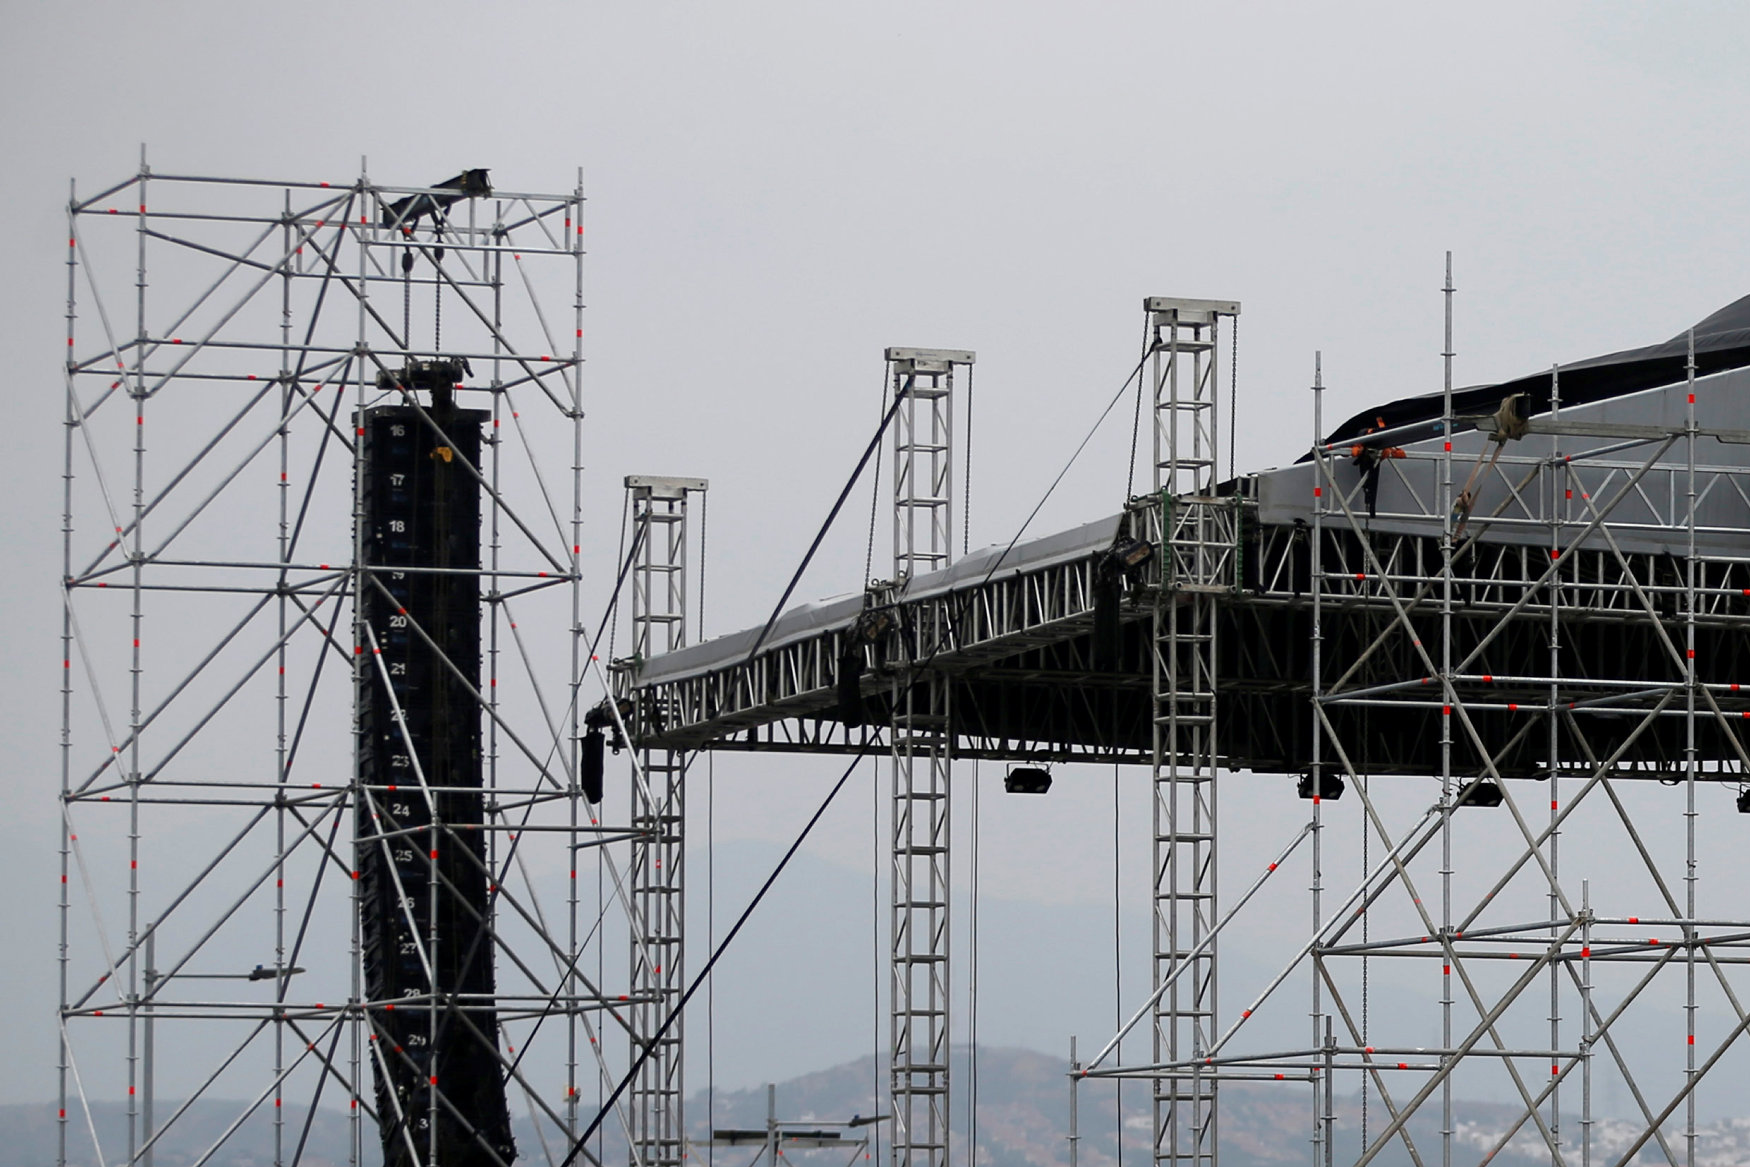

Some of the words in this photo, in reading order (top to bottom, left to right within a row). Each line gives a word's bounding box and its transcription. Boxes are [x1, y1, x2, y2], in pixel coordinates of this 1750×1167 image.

[390, 425, 405, 436] 16
[390, 474, 405, 486] 17
[389, 520, 405, 532] 18
[390, 615, 407, 628] 20
[392, 803, 410, 817] 24
[395, 850, 413, 862] 25
